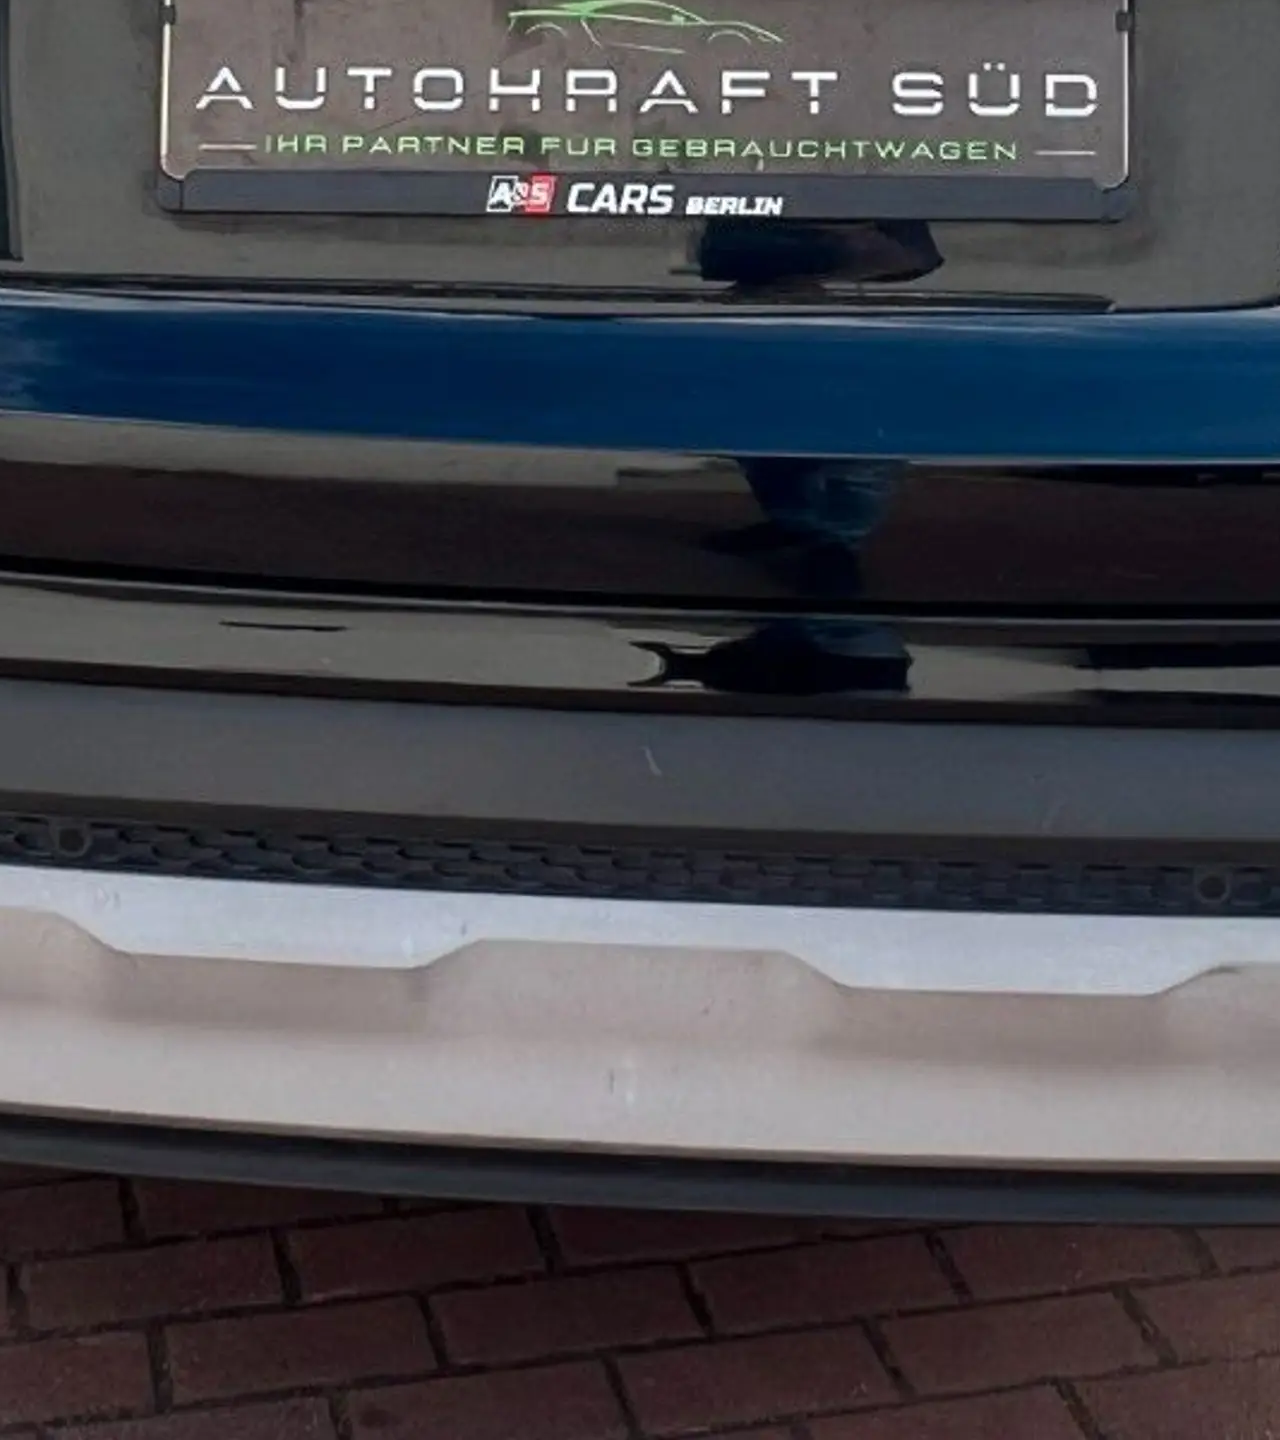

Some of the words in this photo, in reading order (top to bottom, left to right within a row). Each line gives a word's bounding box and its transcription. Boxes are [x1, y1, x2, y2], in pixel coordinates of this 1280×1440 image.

[891, 61, 1099, 117] SÜD
[264, 134, 327, 155] IHR
[341, 135, 526, 157] PARTNER
[631, 138, 1018, 161] GEBRAUCHTWAGEN
[567, 182, 676, 215] CARS
[685, 196, 783, 216] BERLIN
